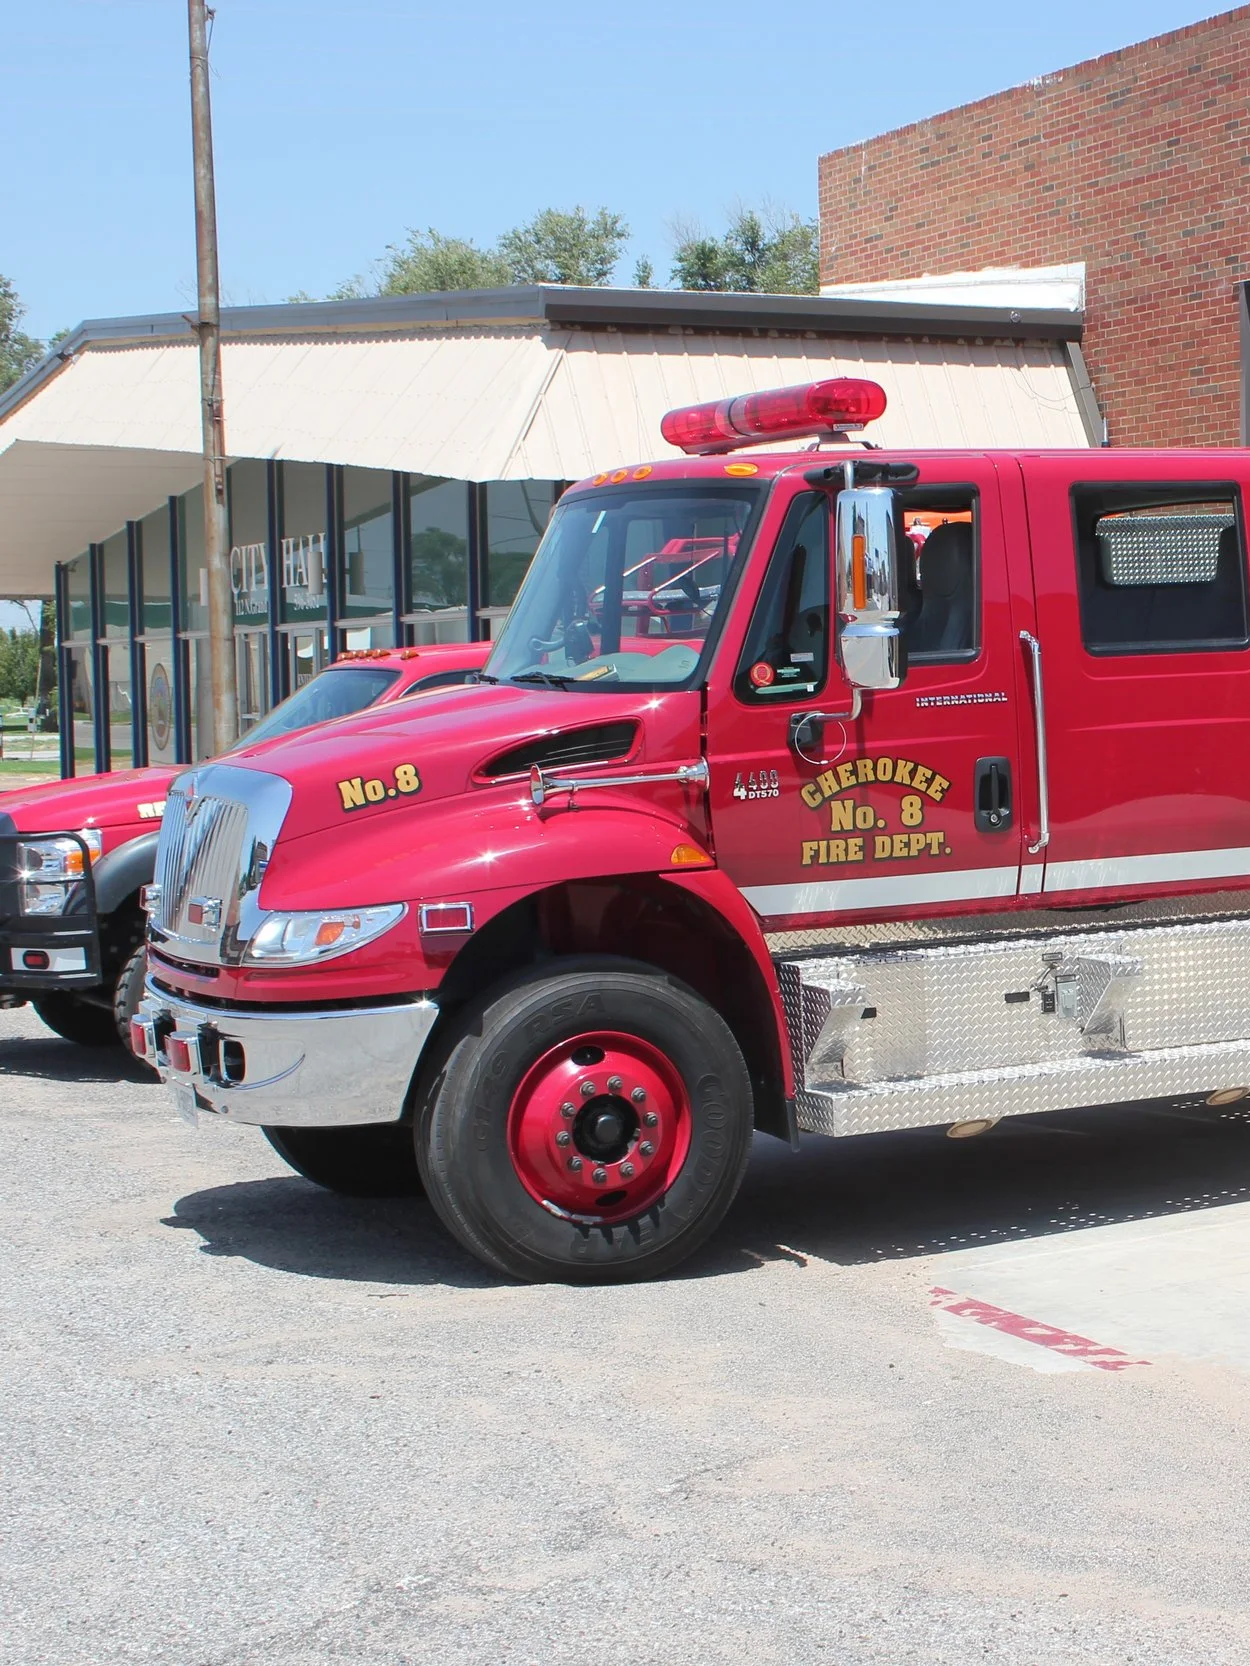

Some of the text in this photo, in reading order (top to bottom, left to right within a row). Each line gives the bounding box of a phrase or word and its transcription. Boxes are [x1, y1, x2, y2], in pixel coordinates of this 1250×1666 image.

[230, 542, 269, 594] CITY
[915, 692, 1008, 708] INTERNATIONAL
[748, 789, 779, 799] DT570
[800, 756, 951, 808] CHEROKEE
[830, 794, 923, 833] No. 8
[801, 831, 952, 866] FIRE DEPT.
